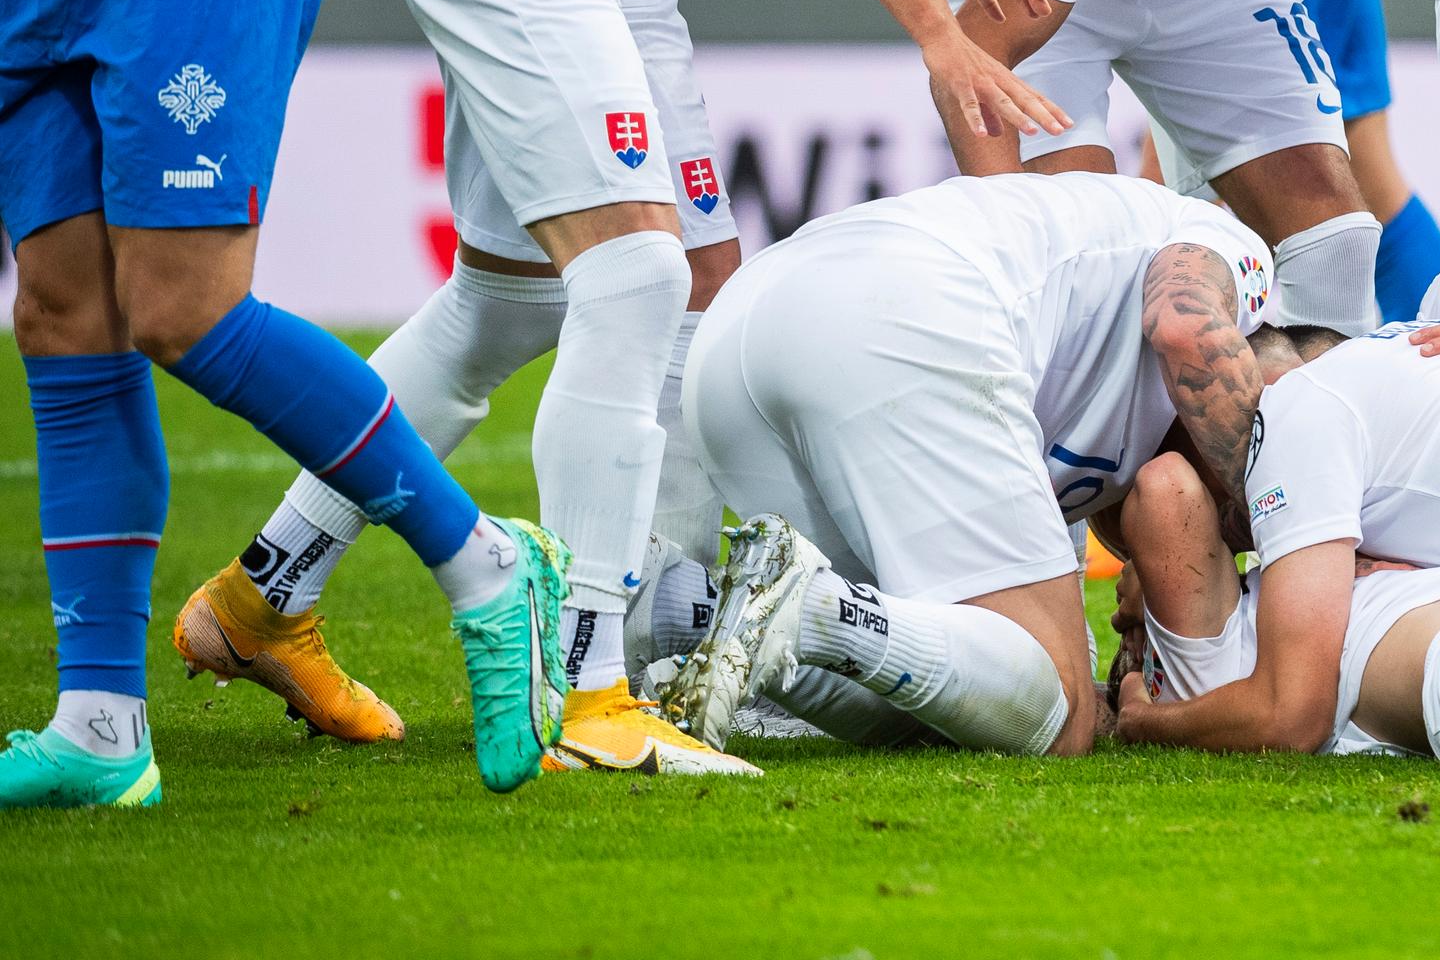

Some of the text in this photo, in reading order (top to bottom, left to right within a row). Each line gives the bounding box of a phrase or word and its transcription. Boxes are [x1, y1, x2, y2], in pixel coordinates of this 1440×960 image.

[163, 170, 214, 188] PUMA
[1252, 489, 1285, 515] ATION
[859, 607, 889, 637] TAPED
